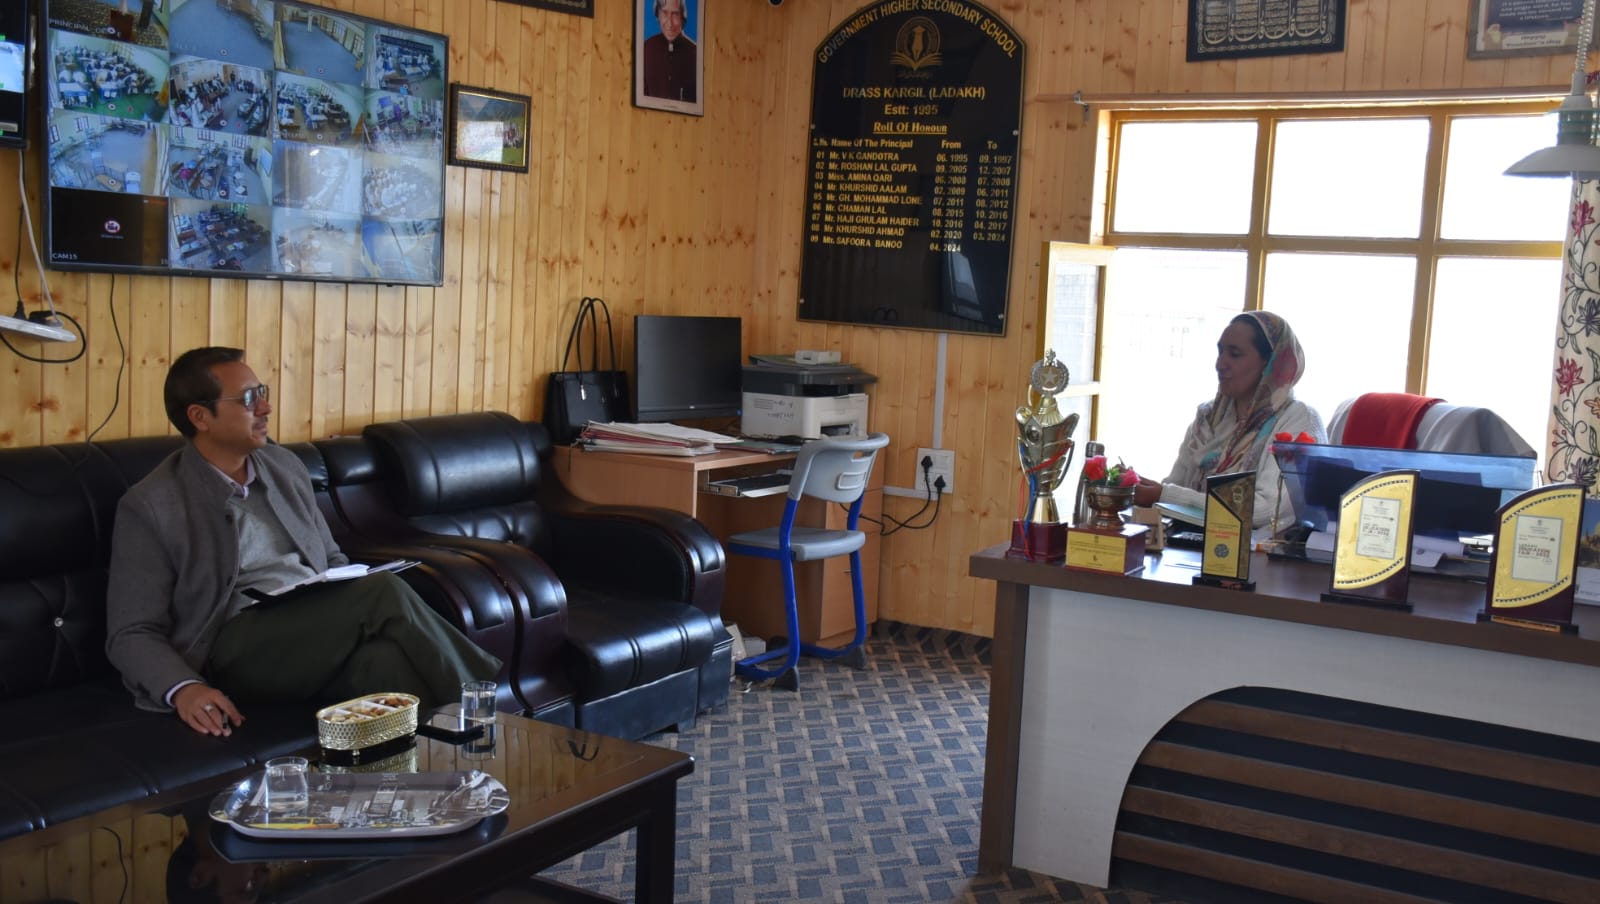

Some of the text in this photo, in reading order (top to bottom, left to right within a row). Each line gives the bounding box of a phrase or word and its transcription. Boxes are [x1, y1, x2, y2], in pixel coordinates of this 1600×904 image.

[818, 0, 1018, 64] GOVERNMENT HIGHER SECONDARY SCHOOL
[843, 87, 986, 100] DRASS KARGIL (LADAKH)
[885, 104, 938, 115] Estt: 1995
[874, 121, 893, 133] Roll
[896, 121, 909, 132] Of
[831, 139, 851, 148] Name
[854, 139, 862, 147] Of
[864, 139, 879, 148] The
[880, 139, 914, 149] Principal
[942, 140, 961, 149] From
[987, 141, 998, 150] To
[829, 152, 839, 160] Mr.
[842, 152, 848, 160] V
[856, 152, 900, 161] GANDOTRA
[951, 154, 968, 163] 1995
[816, 162, 825, 170] 02
[828, 162, 838, 170] Mr.
[841, 162, 873, 171] ROSHAN
[874, 163, 889, 172] LAL
[891, 163, 918, 172] GUPTA
[815, 172, 824, 180] 03
[847, 173, 871, 182] AMINA
[873, 174, 893, 183] QARI
[814, 182, 823, 190] 04
[840, 183, 878, 192] KHURSHID
[879, 184, 907, 194] AALAM
[853, 194, 900, 204] MOHAMMAD
[901, 196, 923, 205] LONE
[946, 197, 964, 206] 2011
[837, 204, 870, 213] CHAMAN
[871, 205, 887, 214] LAL
[945, 208, 964, 217] 2015
[812, 213, 820, 221] 07
[837, 214, 854, 223] HAJI
[855, 215, 888, 225] GHULAM
[889, 217, 919, 226] HAIDER
[944, 219, 963, 228] 2016
[987, 222, 1007, 231] 2017
[811, 223, 820, 231] 08
[836, 225, 875, 235] KHURSHID
[876, 226, 905, 236] AHMAD
[944, 230, 962, 240] 2020
[810, 234, 819, 243] 09
[836, 236, 871, 247] SAFOORA
[875, 239, 903, 249] BANOO
[52, 252, 78, 260] CAM15
